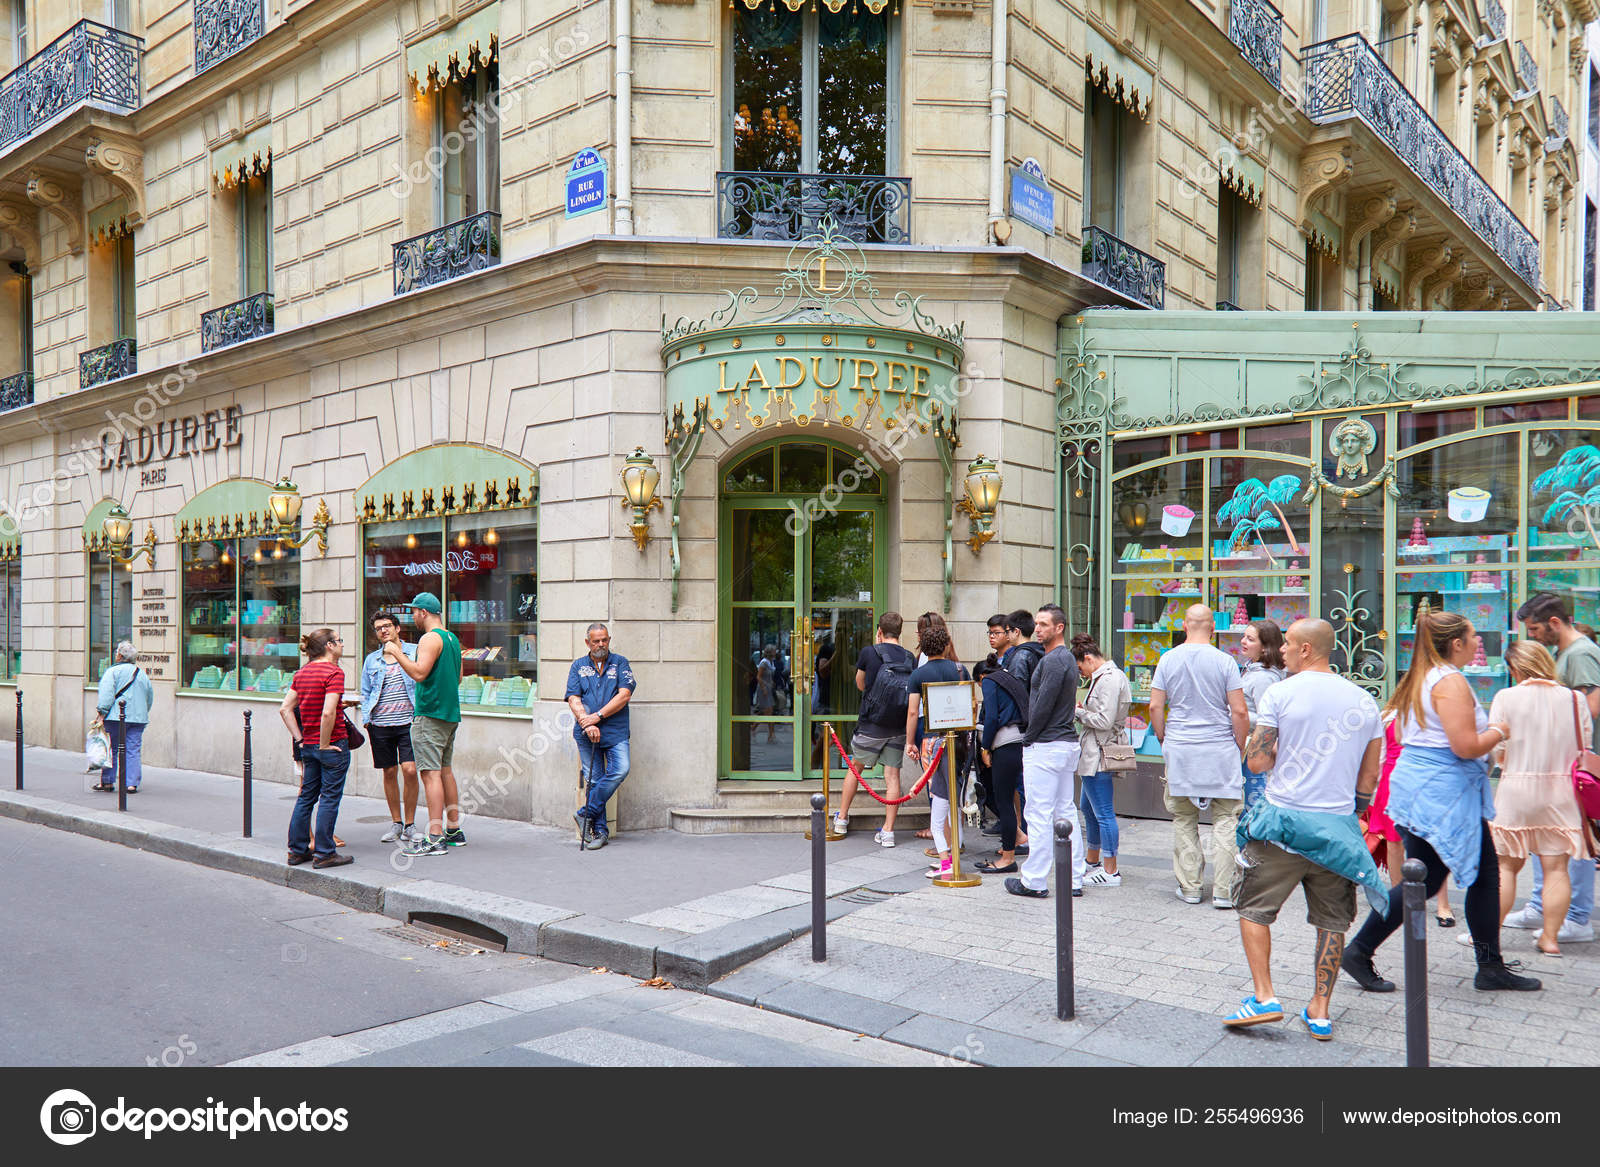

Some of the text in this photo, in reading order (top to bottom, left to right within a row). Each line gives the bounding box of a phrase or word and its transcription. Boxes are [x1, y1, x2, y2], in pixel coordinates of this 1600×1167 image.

[570, 189, 602, 208] LINCOLN
[578, 179, 594, 193] RUE
[815, 256, 844, 291] L
[716, 356, 931, 398] LADUREE
[97, 403, 243, 472] LADUREE
[141, 467, 167, 486] PARIS
